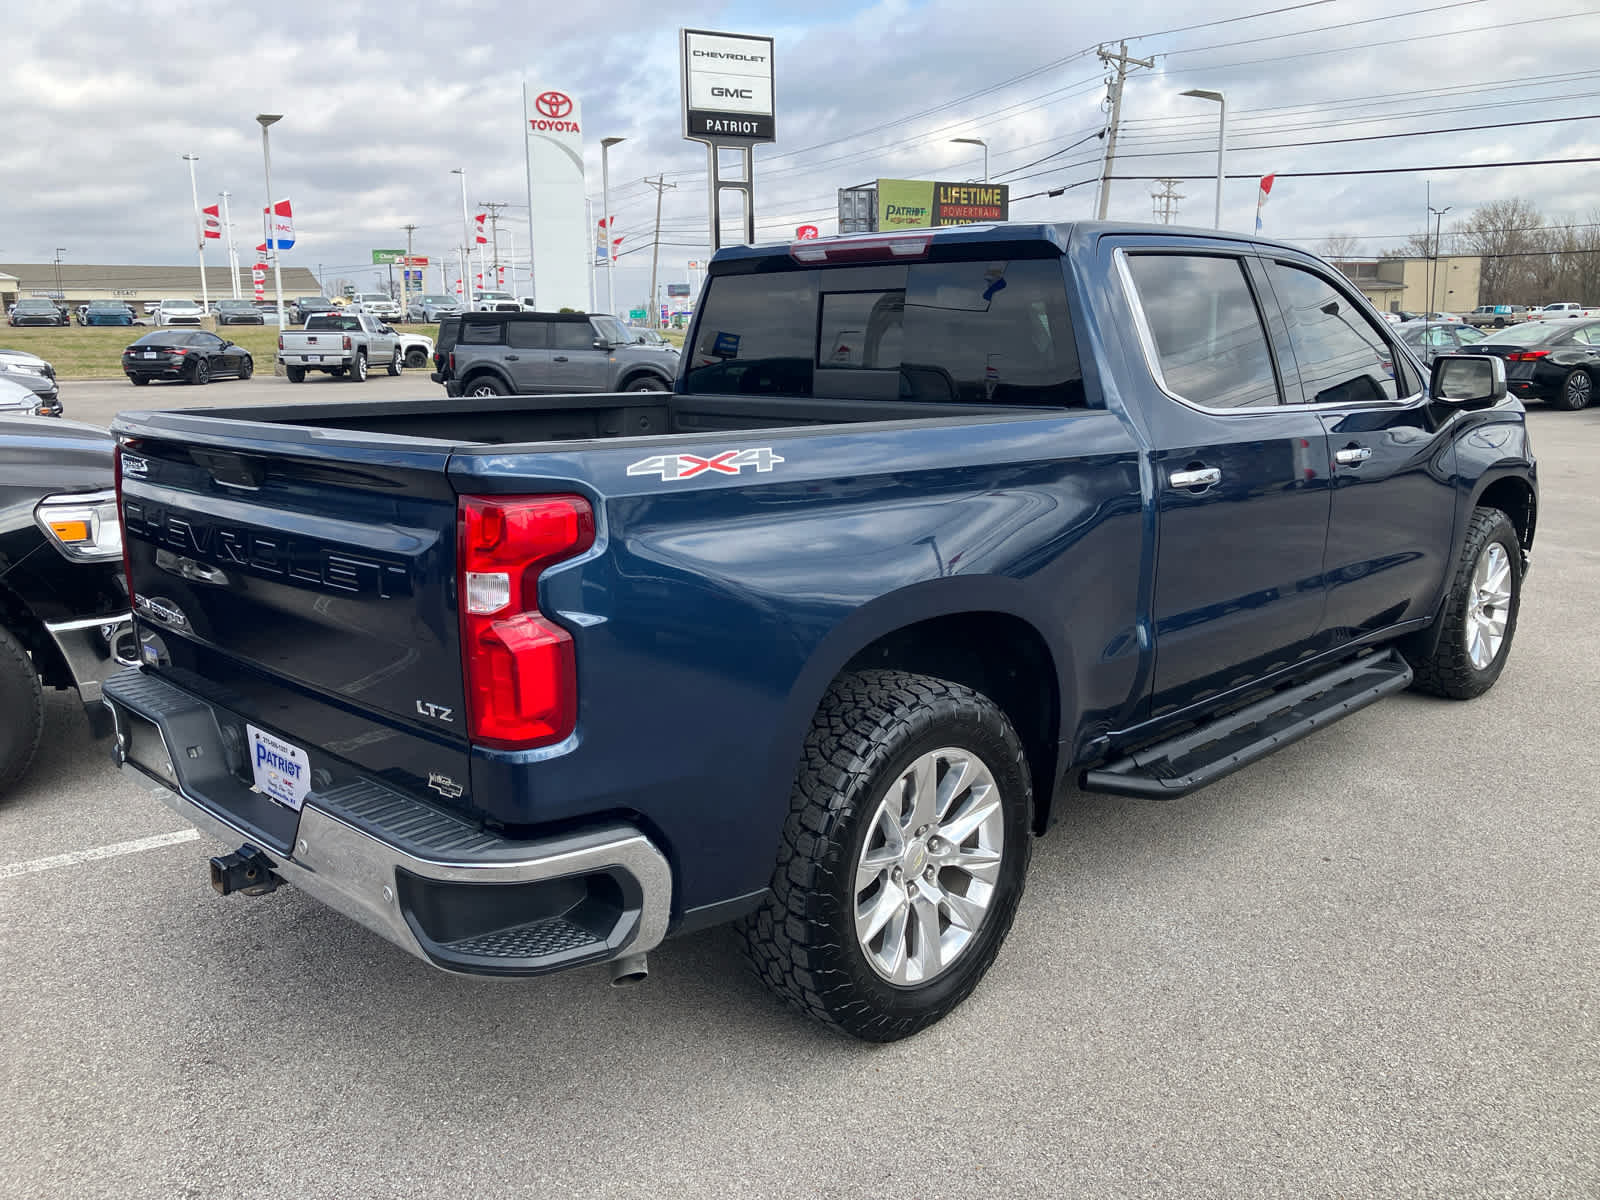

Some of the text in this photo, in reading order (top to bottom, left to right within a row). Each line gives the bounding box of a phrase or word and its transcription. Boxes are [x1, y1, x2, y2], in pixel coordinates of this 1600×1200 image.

[693, 50, 766, 62] CHEVROLET
[711, 87, 753, 99] GMC
[529, 119, 580, 133] TOYOTA
[706, 119, 758, 133] PATRIOT
[940, 186, 1001, 205] LIFETIME
[943, 206, 998, 217] POWERTRAIN
[127, 502, 411, 598] CHEVROLET
[416, 700, 454, 722] LTZ
[256, 743, 301, 779] PATRIOT
